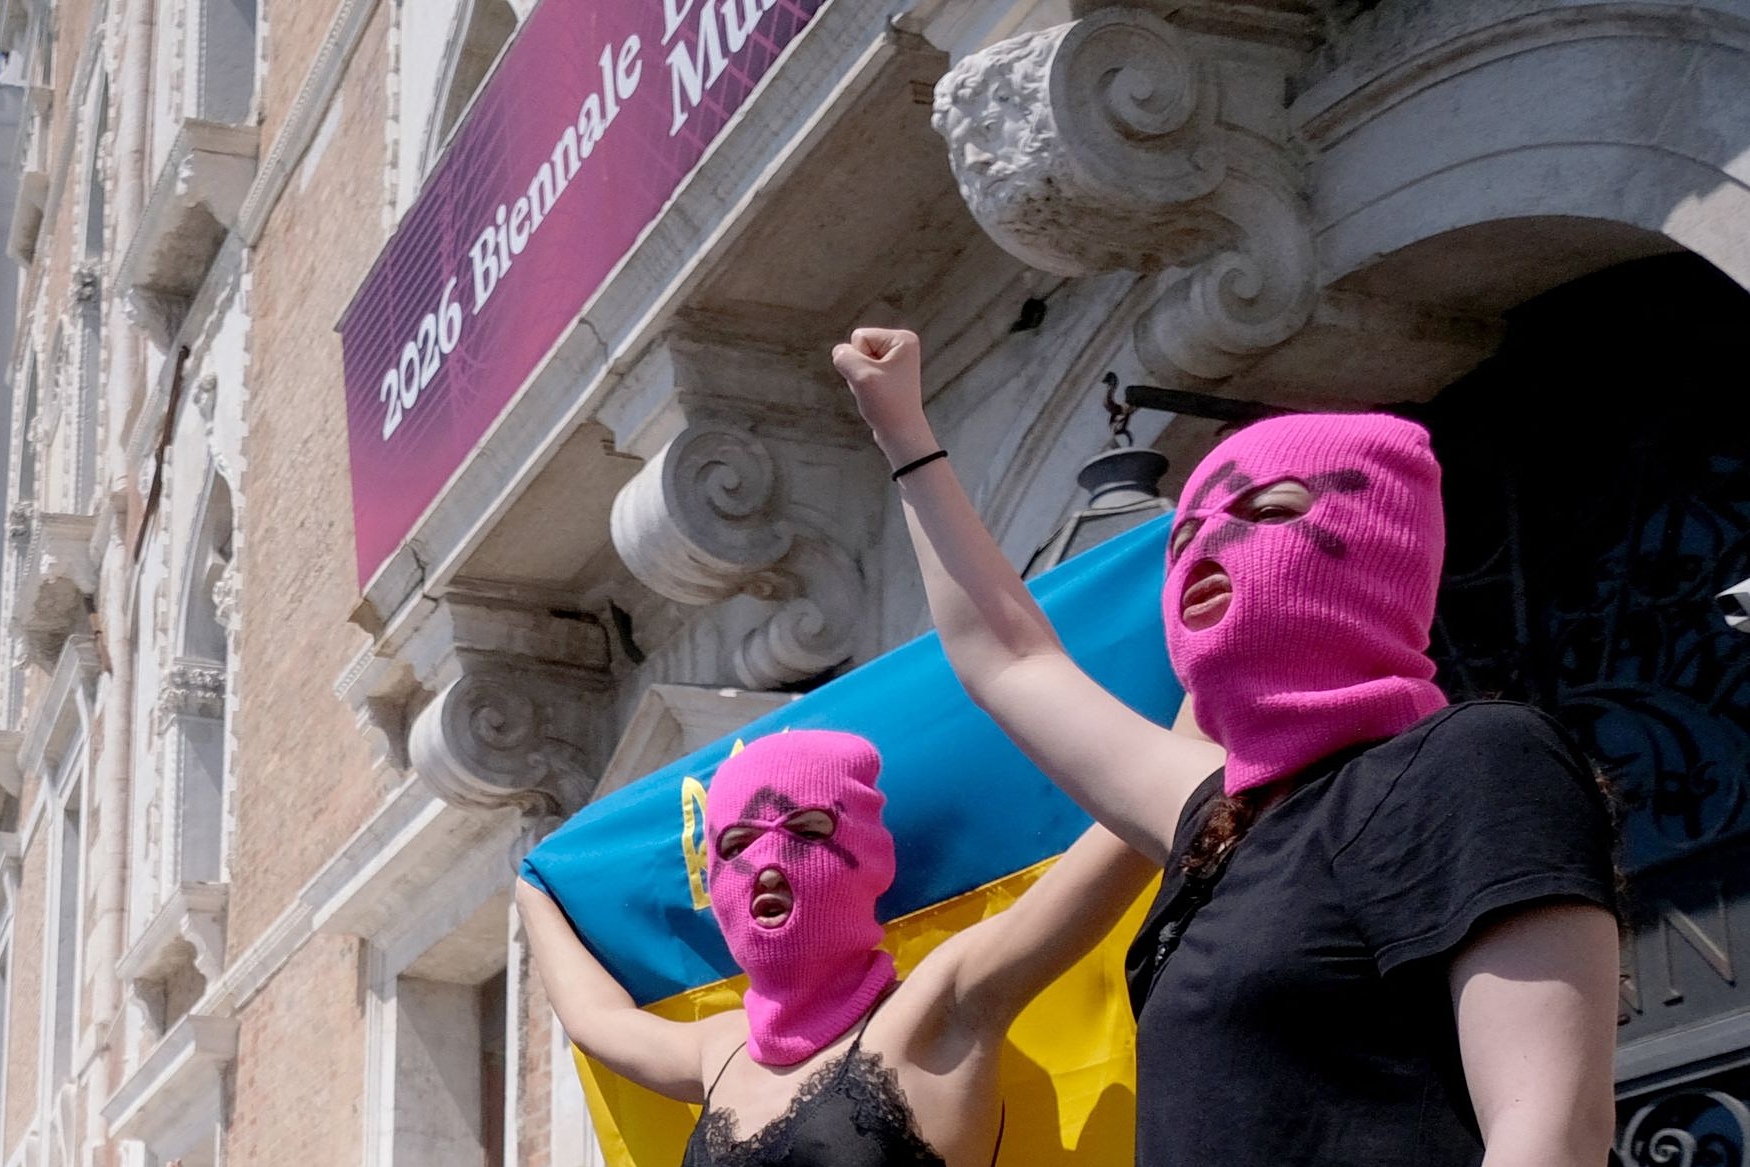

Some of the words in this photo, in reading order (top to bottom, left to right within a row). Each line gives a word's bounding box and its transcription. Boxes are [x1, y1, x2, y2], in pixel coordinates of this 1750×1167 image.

[665, 0, 778, 137] Mu
[380, 276, 463, 441] 2026
[468, 34, 643, 315] Biennale
